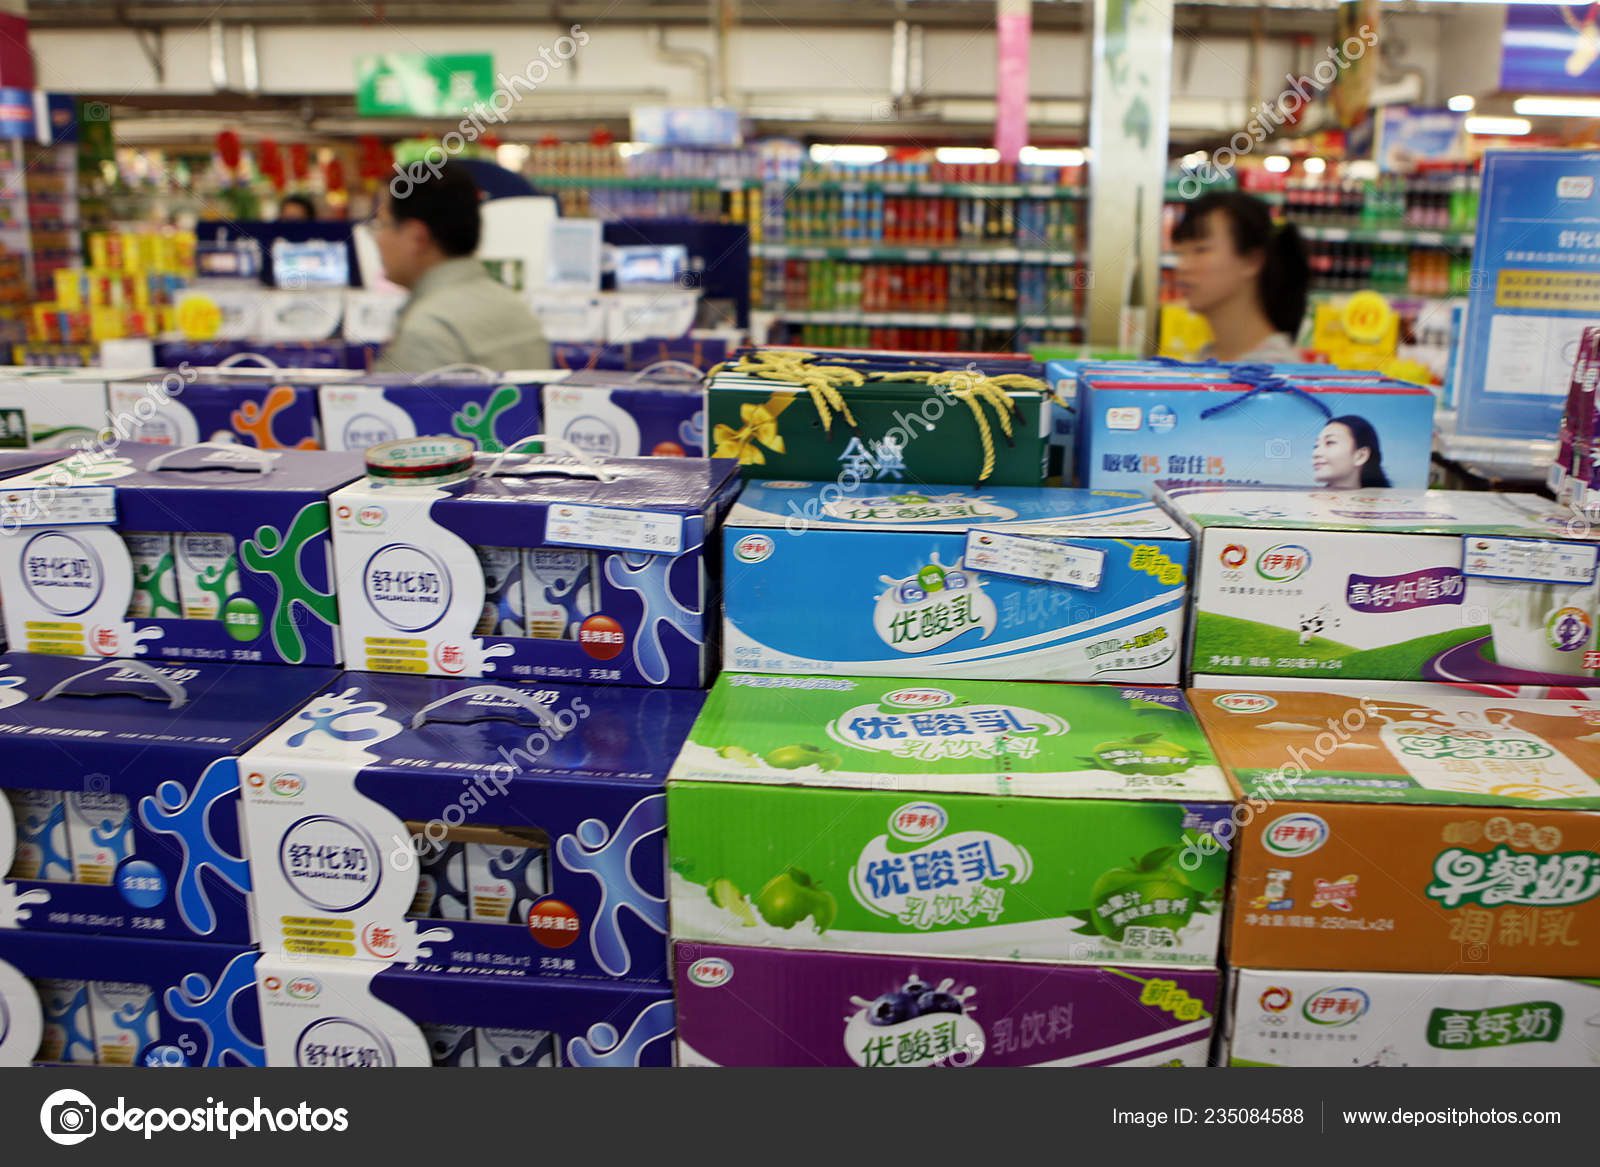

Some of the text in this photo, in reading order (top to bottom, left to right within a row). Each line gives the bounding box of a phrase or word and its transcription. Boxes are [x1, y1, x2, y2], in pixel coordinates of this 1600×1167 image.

[1168, 455, 1225, 475] 留住钙
[29, 556, 92, 579] 舒化奶
[1263, 554, 1304, 571] 伊利
[372, 571, 440, 593] 舒化奶
[1349, 575, 1464, 608] 高钙低脂奶
[889, 593, 981, 644] 优酸乳
[892, 693, 942, 703] 伊利
[848, 708, 1035, 741] 优酸乳
[899, 813, 937, 829] 伊利
[1274, 826, 1317, 842] 伊利
[289, 842, 368, 872] 舒化奶
[866, 840, 1005, 899] 优酸乳
[1427, 849, 1600, 906] 早餐奶
[898, 884, 1005, 930] 乳饮料
[1127, 928, 1173, 948] 原味
[1449, 909, 1581, 947] 调制乳
[1311, 997, 1360, 1015] 伊利
[991, 1003, 1074, 1056] 乳饮料
[1438, 1008, 1553, 1046] 高钙奶
[861, 1020, 968, 1067] 优酸乳
